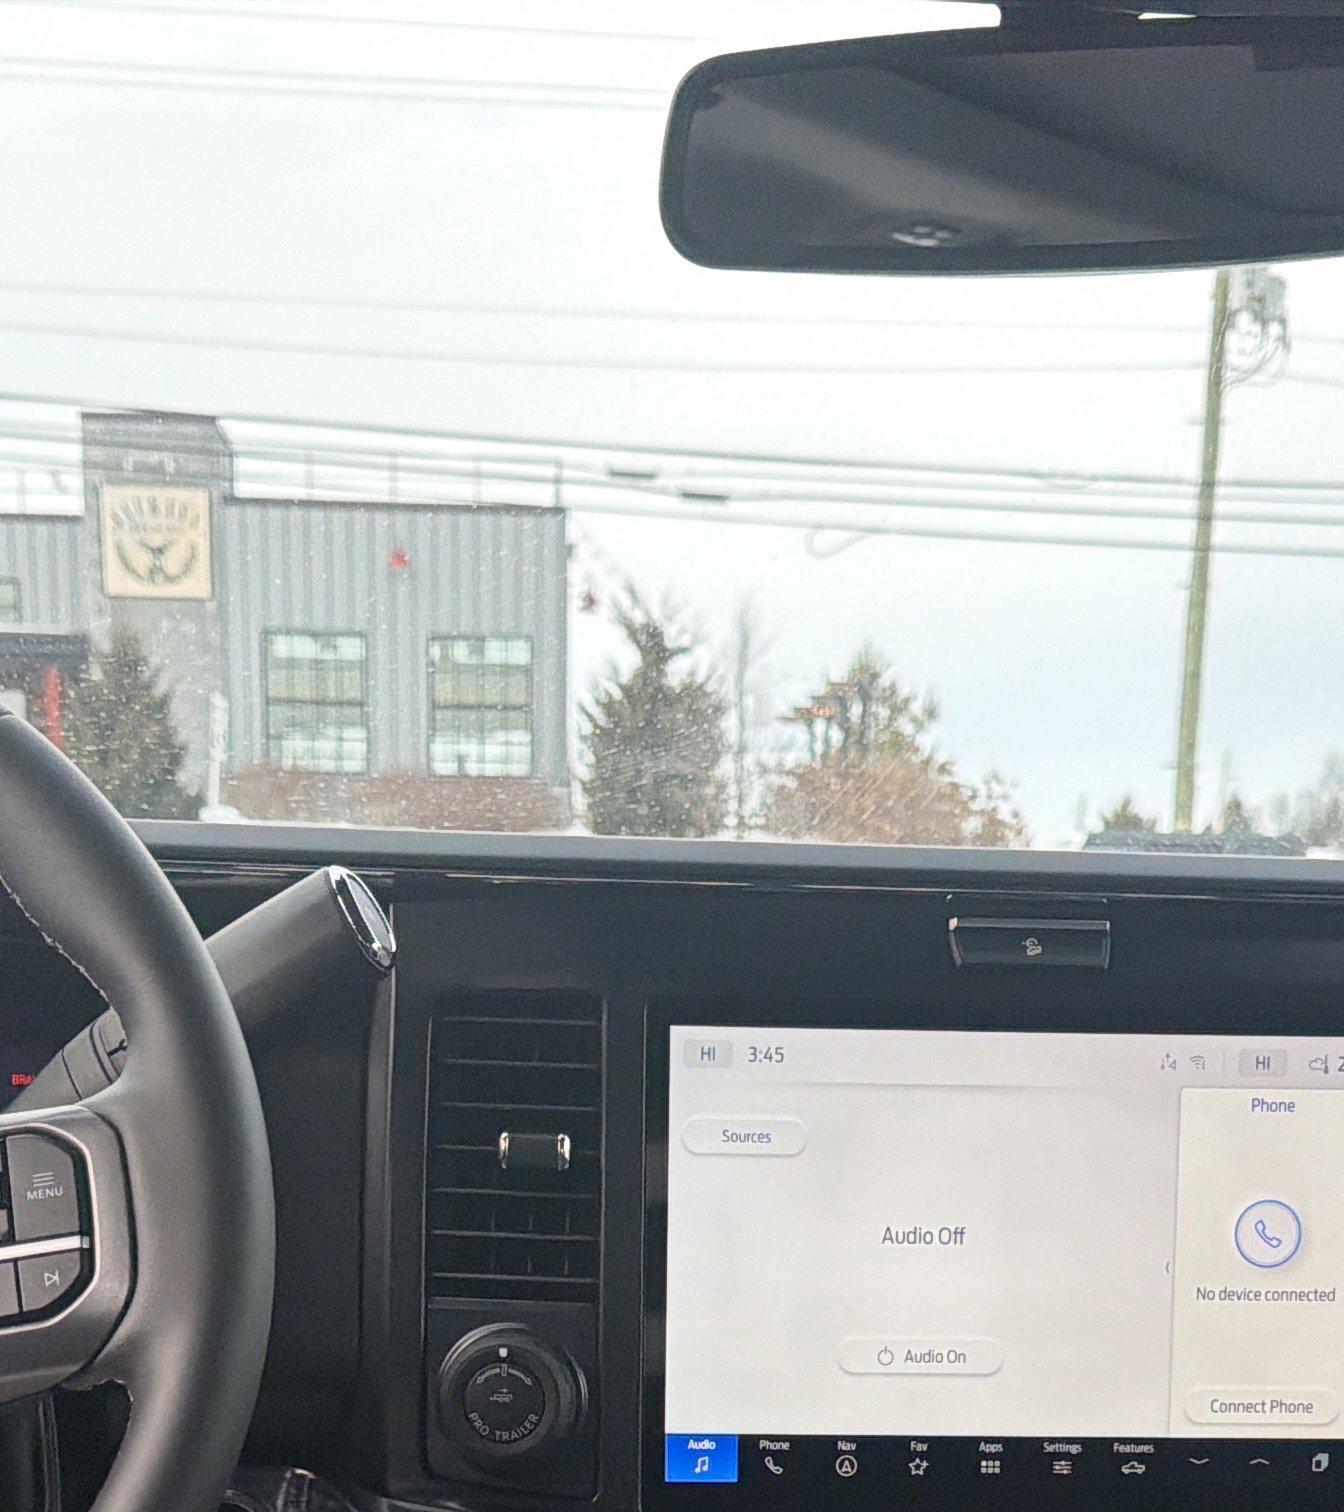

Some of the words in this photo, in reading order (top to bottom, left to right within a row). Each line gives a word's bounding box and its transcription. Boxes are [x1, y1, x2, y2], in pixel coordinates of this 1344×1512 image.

[701, 1047, 716, 1061] HI
[748, 1045, 785, 1064] 3:45
[1255, 1055, 1271, 1071] HI
[11, 1073, 35, 1087] BRA
[1251, 1097, 1296, 1113] Phone
[721, 1128, 772, 1144] Sources
[26, 1186, 63, 1201] MENU
[881, 1225, 933, 1245] Audio
[938, 1226, 966, 1246] Off
[1196, 1286, 1216, 1301] No
[1218, 1286, 1262, 1302] device
[1264, 1287, 1337, 1302] connected
[903, 1348, 944, 1364] Audio
[946, 1349, 967, 1364] On
[1210, 1399, 1265, 1414] Connect
[1268, 1399, 1314, 1414] Phone
[468, 1412, 490, 1437] PRO
[494, 1412, 540, 1442] TRAILER
[687, 1438, 717, 1450] Audio
[759, 1439, 790, 1451] Phone
[837, 1440, 857, 1451] Nav
[910, 1440, 929, 1452] Fav
[978, 1441, 1004, 1454] Apps
[1043, 1441, 1083, 1455] Settings
[1113, 1442, 1155, 1454] Features
